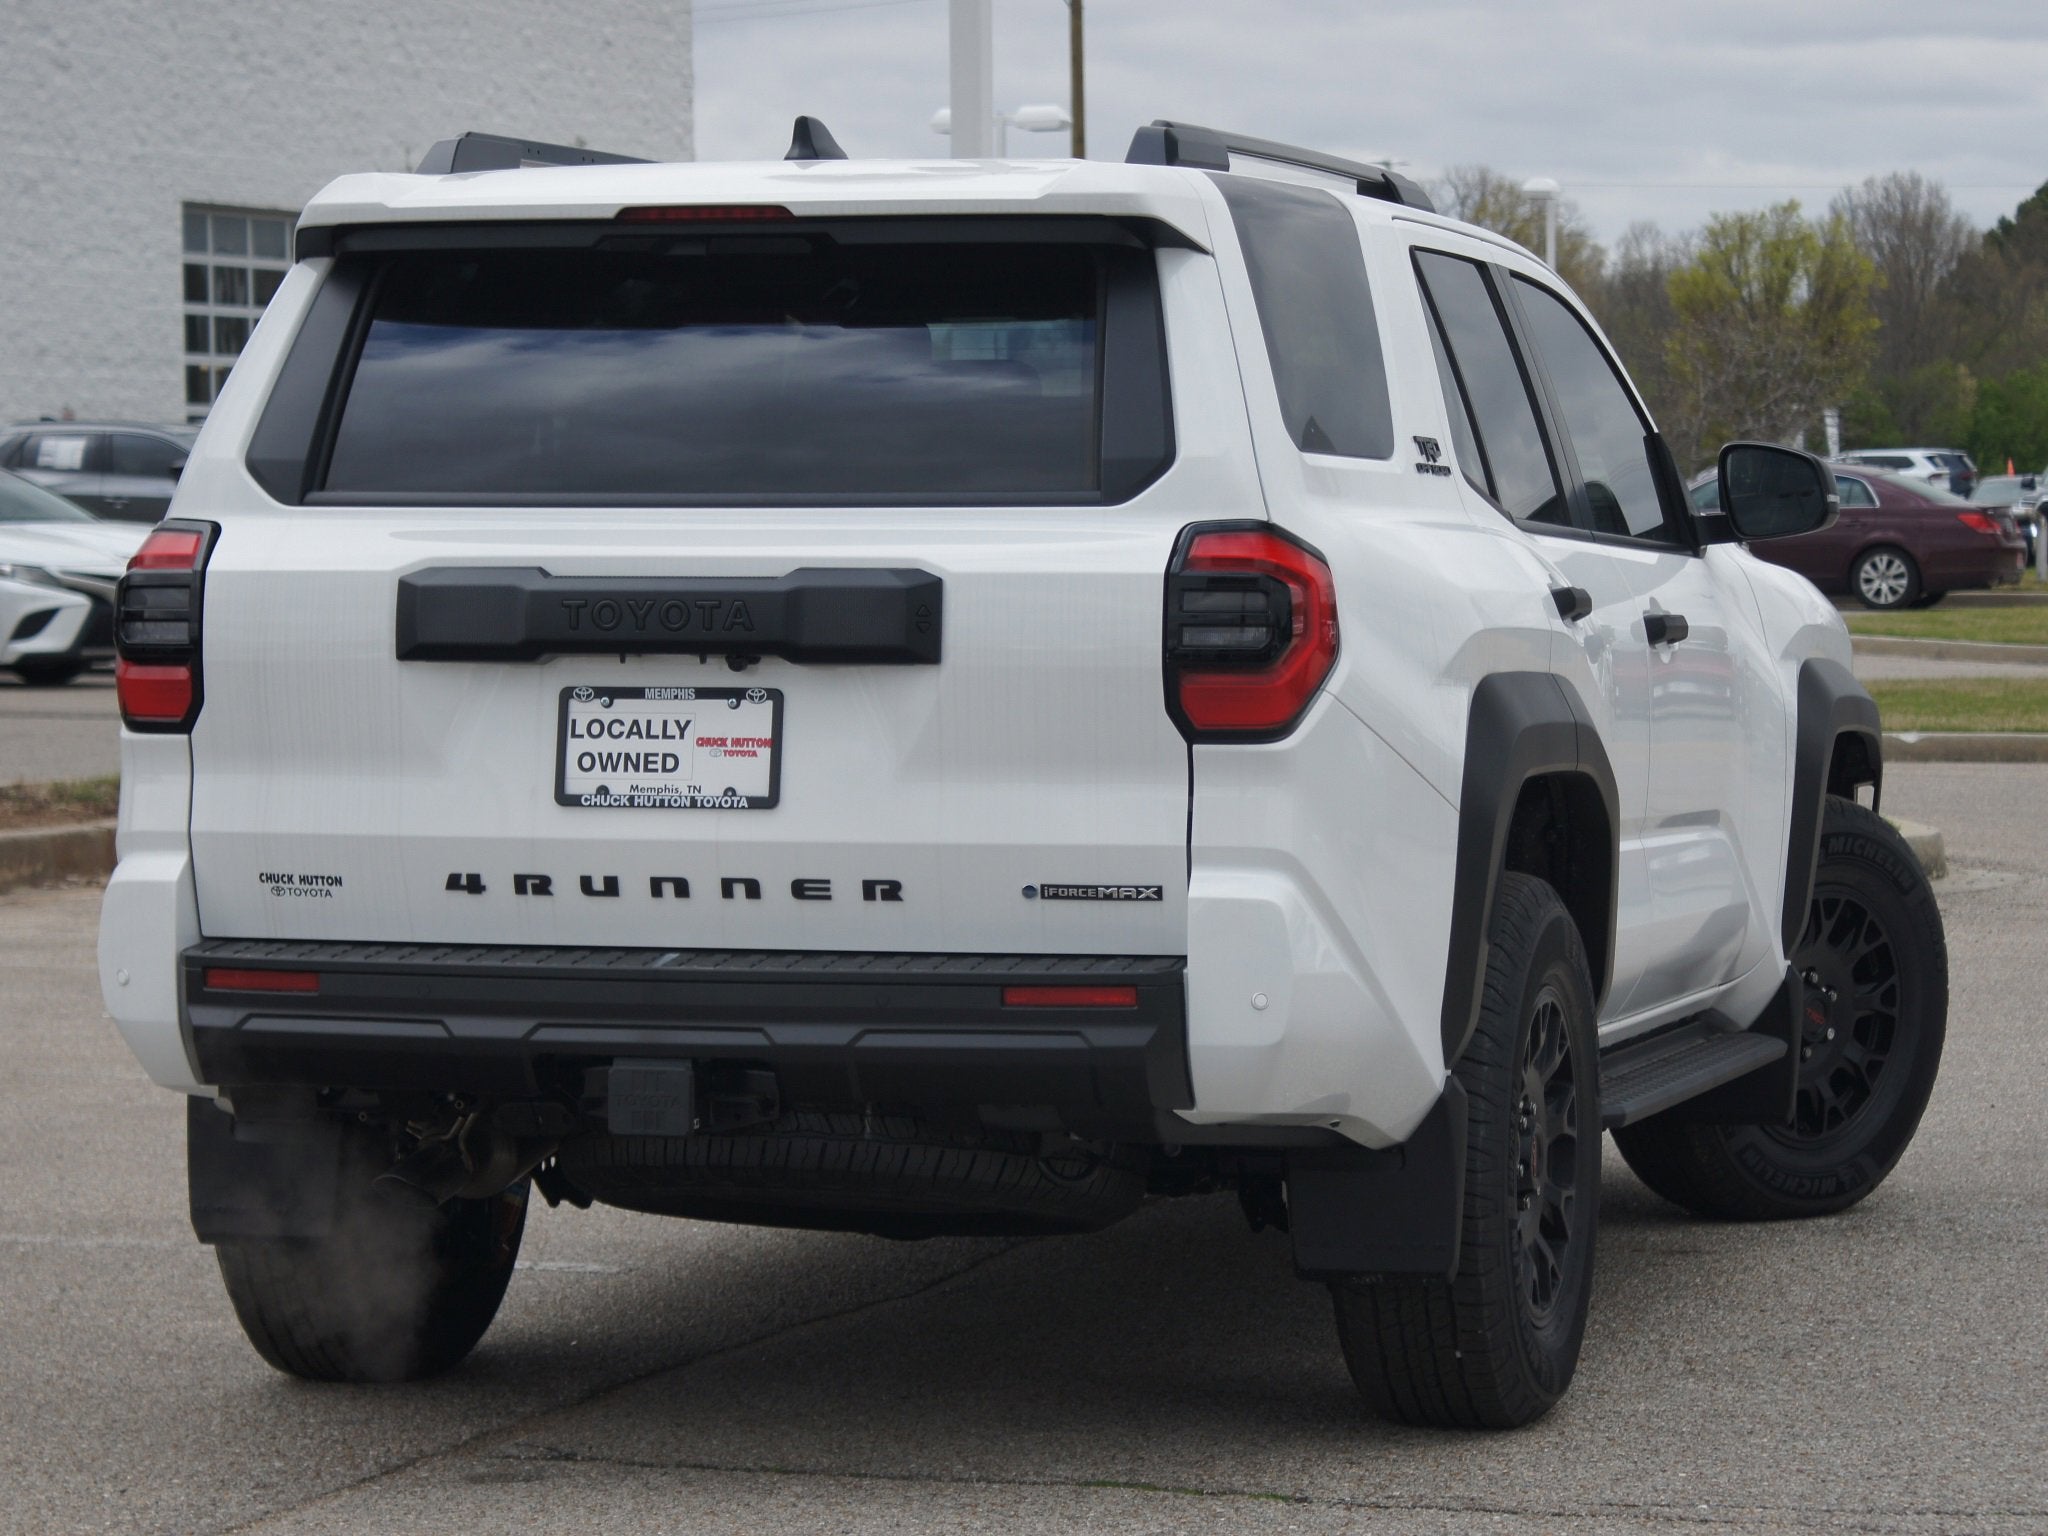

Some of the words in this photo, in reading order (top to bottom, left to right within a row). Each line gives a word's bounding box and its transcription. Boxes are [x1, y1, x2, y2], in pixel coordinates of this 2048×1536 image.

[561, 599, 756, 633] TOYOTA
[644, 687, 696, 700] MEMPHIS
[570, 718, 692, 740] LOCALLY
[695, 737, 727, 748] CHUCK
[731, 738, 773, 748] HUTTON
[723, 749, 758, 758] TOYOTA
[577, 751, 680, 773] OWNED
[629, 784, 682, 796] Memphis,
[686, 785, 702, 795] TN
[581, 794, 630, 807] CHUCK
[633, 795, 691, 808] HUTTON
[694, 796, 749, 809] TOYOTA
[1828, 836, 1917, 891] MICHELIN
[258, 872, 295, 885] CHUCK
[298, 875, 343, 887] HUTTON
[287, 887, 333, 898] TOYOTA
[1742, 1148, 1838, 1195] MICHELIN
